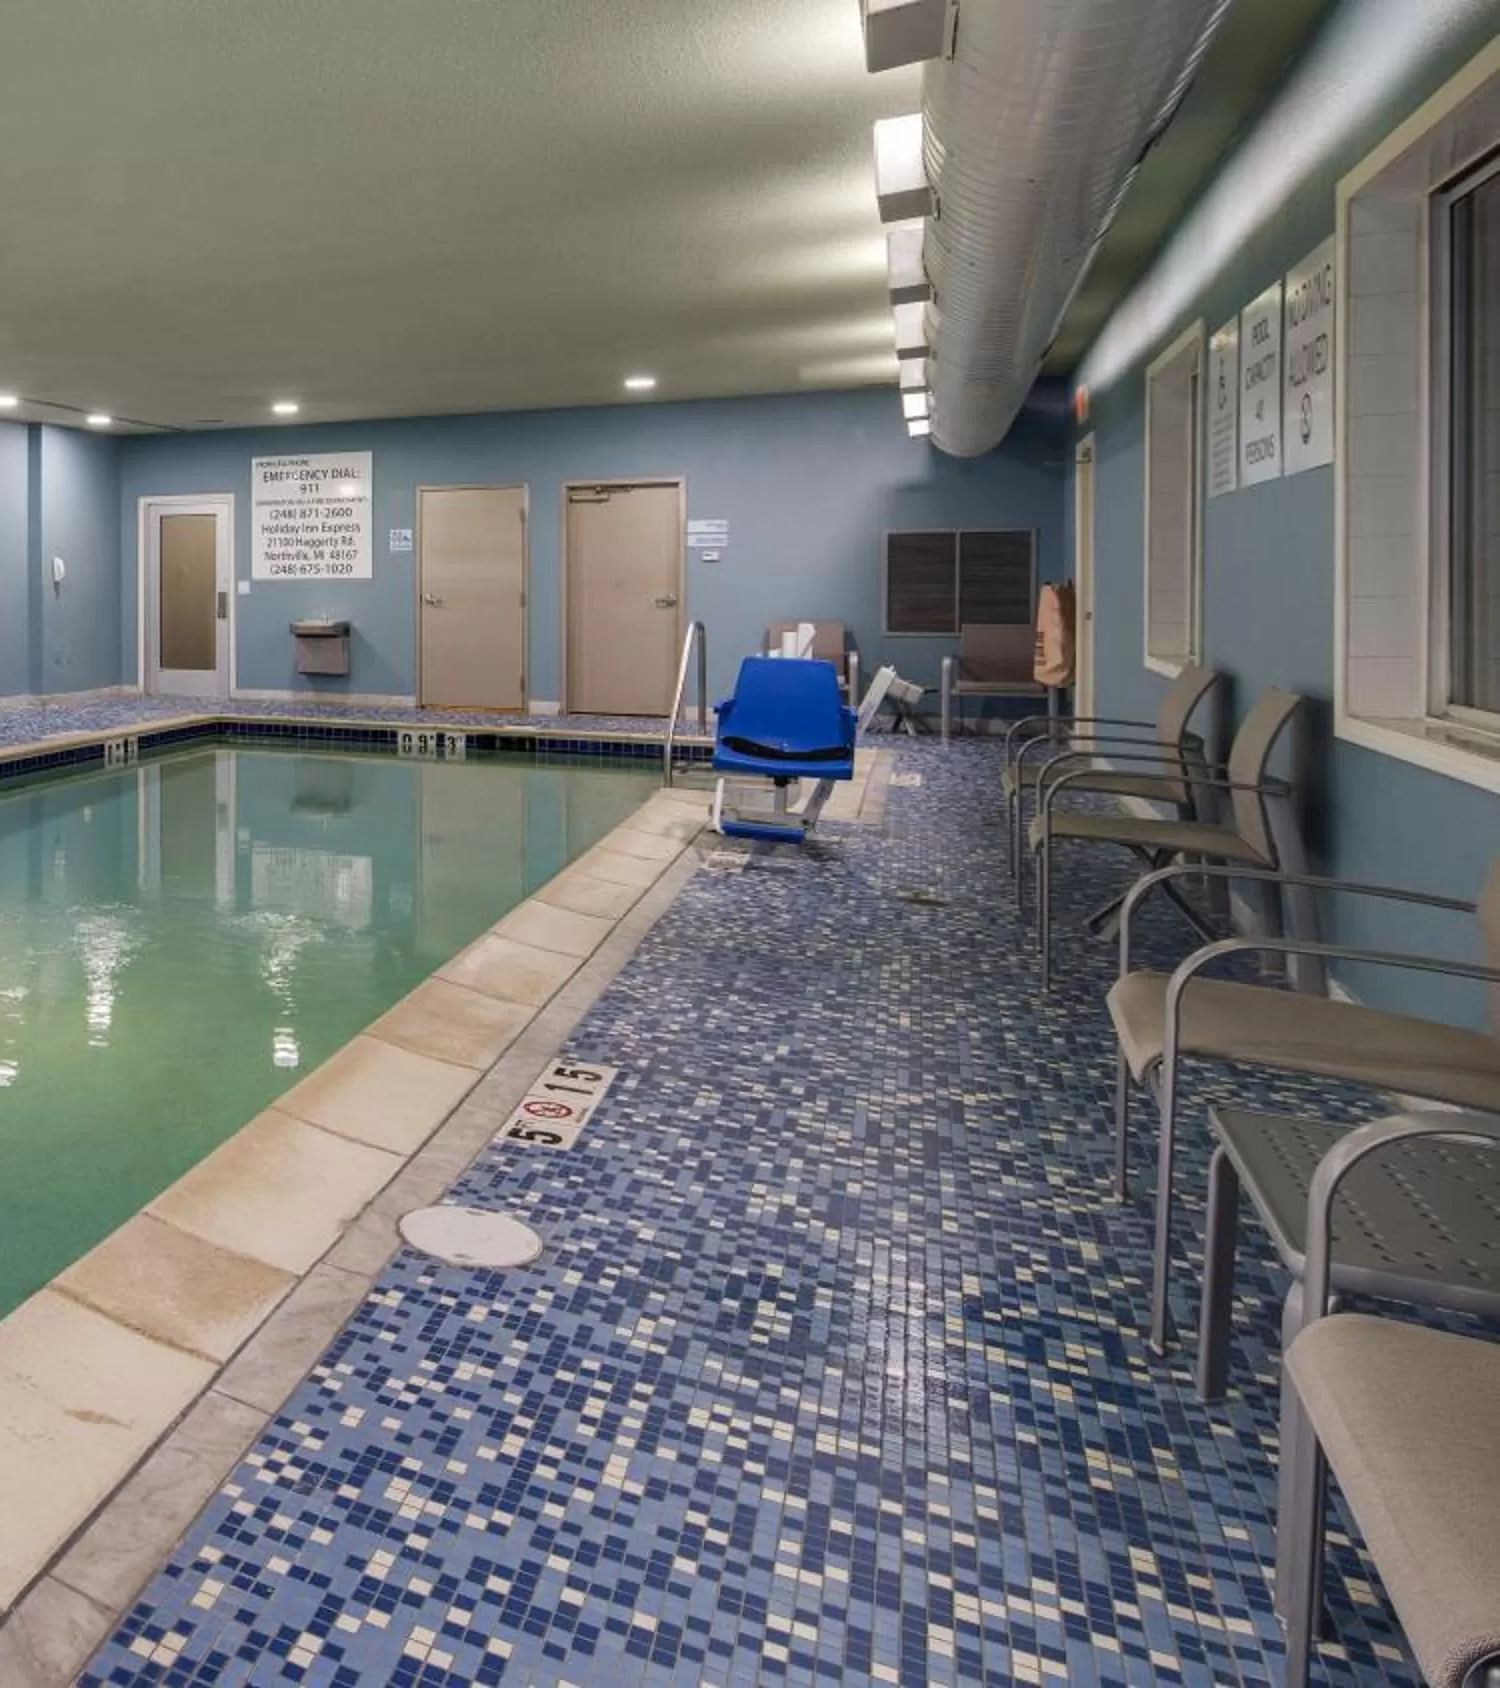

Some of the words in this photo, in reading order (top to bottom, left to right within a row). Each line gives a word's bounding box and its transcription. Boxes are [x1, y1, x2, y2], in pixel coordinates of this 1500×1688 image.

[1251, 317, 1271, 347] POOL
[1245, 432, 1276, 464] PERSONS
[262, 469, 329, 483] EMERGENCY
[299, 484, 320, 494] 911
[269, 509, 297, 520] (248)
[299, 507, 353, 519] 871-2600
[262, 523, 299, 535] Holiday
[301, 523, 319, 533] Inn
[321, 522, 361, 534] Express
[296, 537, 338, 549] Haggerty
[329, 549, 358, 561] 48167
[269, 564, 297, 576] (248)
[299, 563, 353, 575] 675-1020
